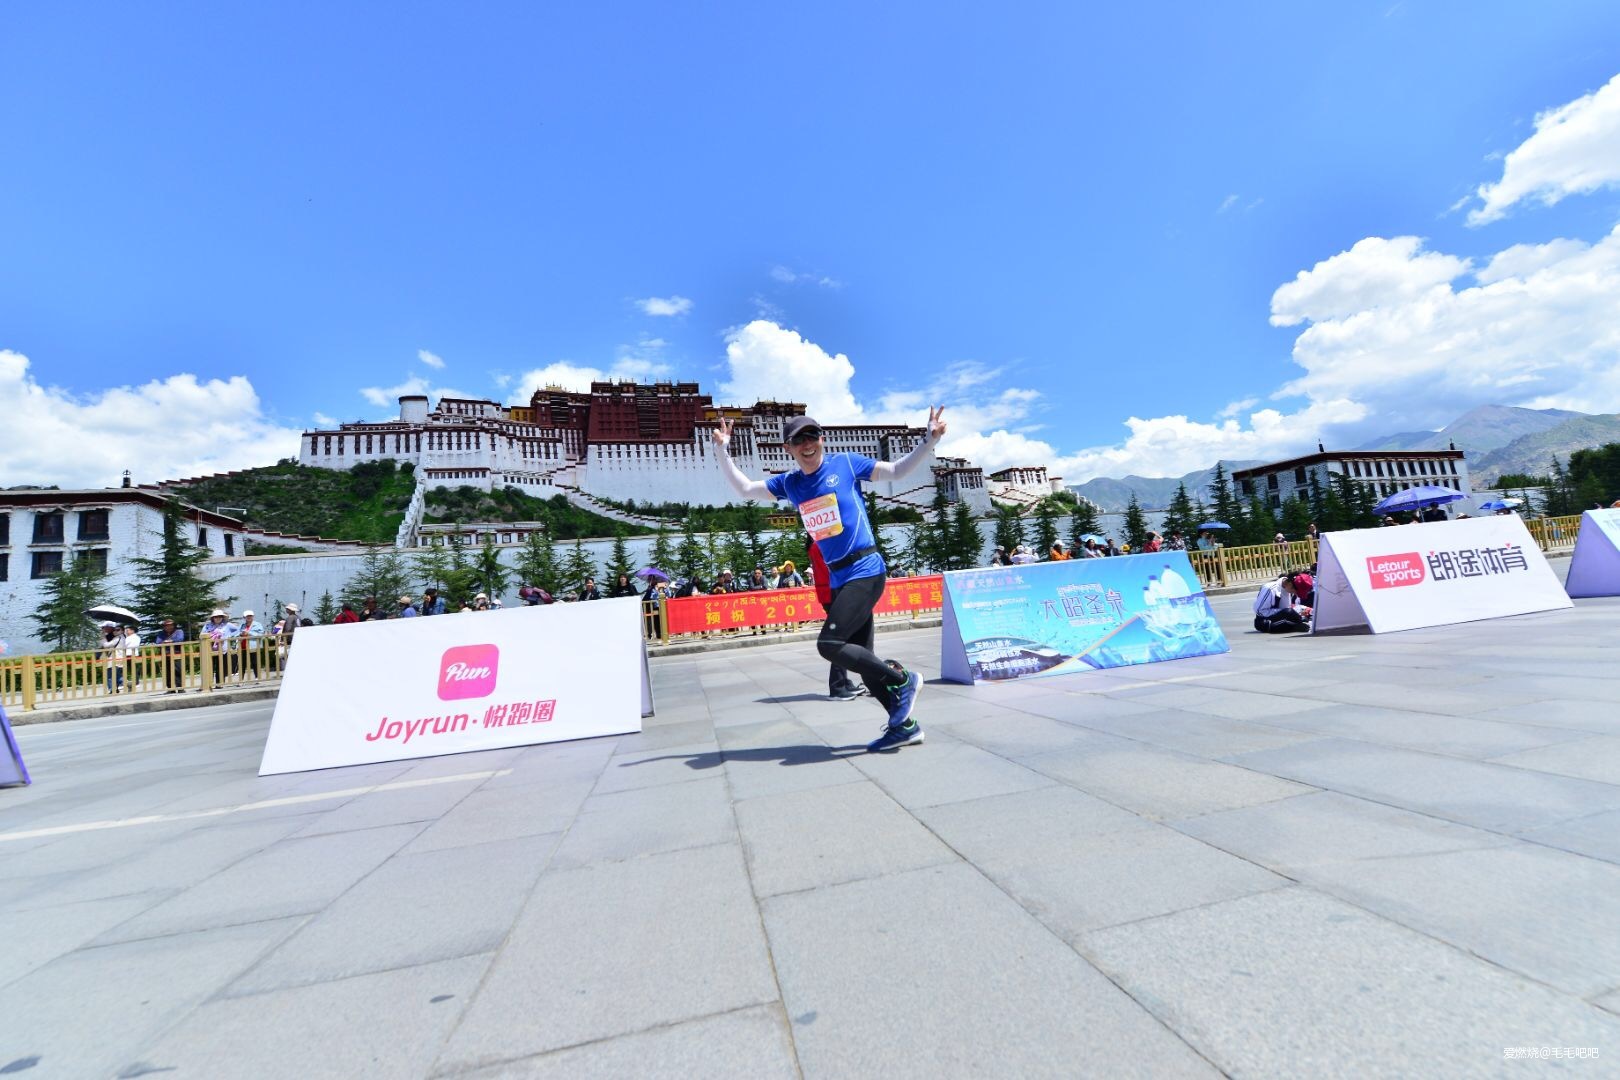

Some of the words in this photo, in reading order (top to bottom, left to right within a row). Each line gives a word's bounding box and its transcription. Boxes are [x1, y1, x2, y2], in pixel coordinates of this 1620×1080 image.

[1369, 560, 1410, 573] Letour
[1426, 543, 1528, 581] 朗途体育
[1383, 568, 1421, 585] sports
[706, 609, 745, 625] 预祝
[766, 602, 827, 619] 201
[1039, 587, 1127, 620] 大昭圣泉
[445, 662, 491, 682] Run
